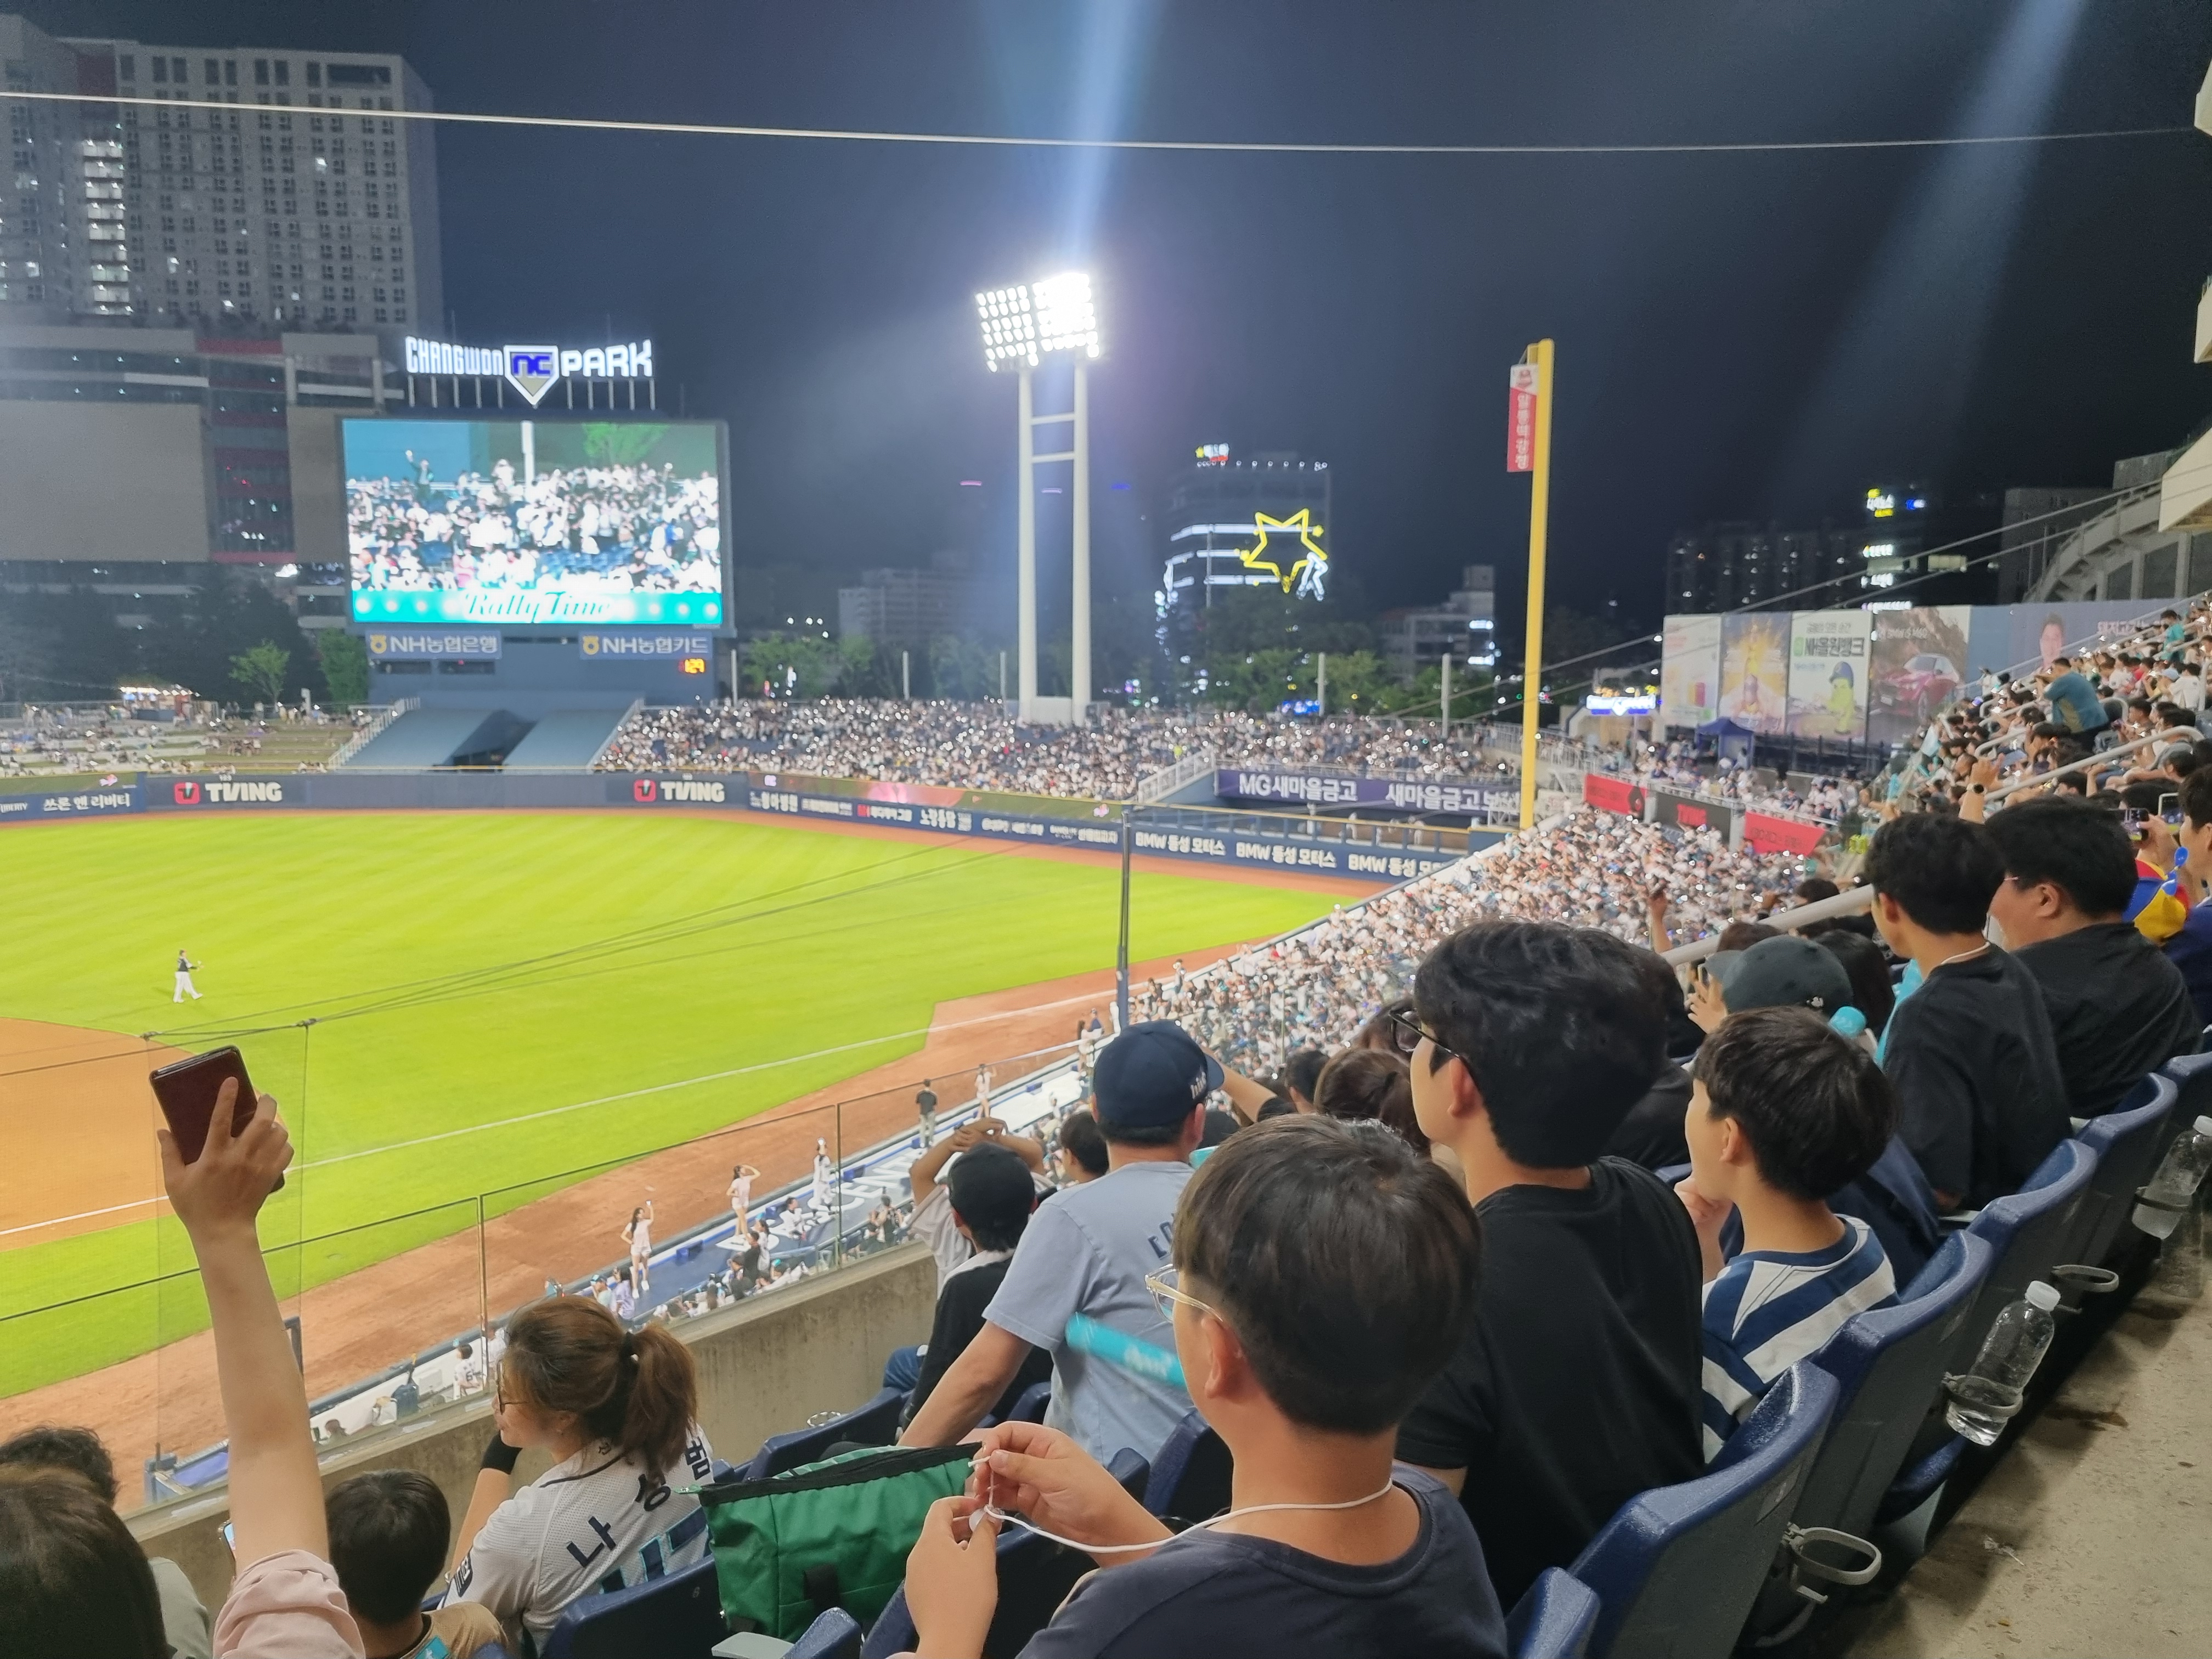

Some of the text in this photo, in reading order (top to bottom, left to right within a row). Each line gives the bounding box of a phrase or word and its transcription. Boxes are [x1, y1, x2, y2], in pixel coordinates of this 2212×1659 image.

[405, 336, 503, 376] CHANGWON
[560, 339, 653, 377] PARK
[465, 590, 610, 623] Rally Time
[390, 636, 498, 654] NH농협은행
[602, 636, 710, 655] NH농협카드
[205, 782, 283, 803] TVING
[660, 781, 725, 803] TVING
[1135, 831, 1167, 849] BMW
[1236, 842, 1271, 861] BMW
[1348, 853, 1387, 874] BMW
